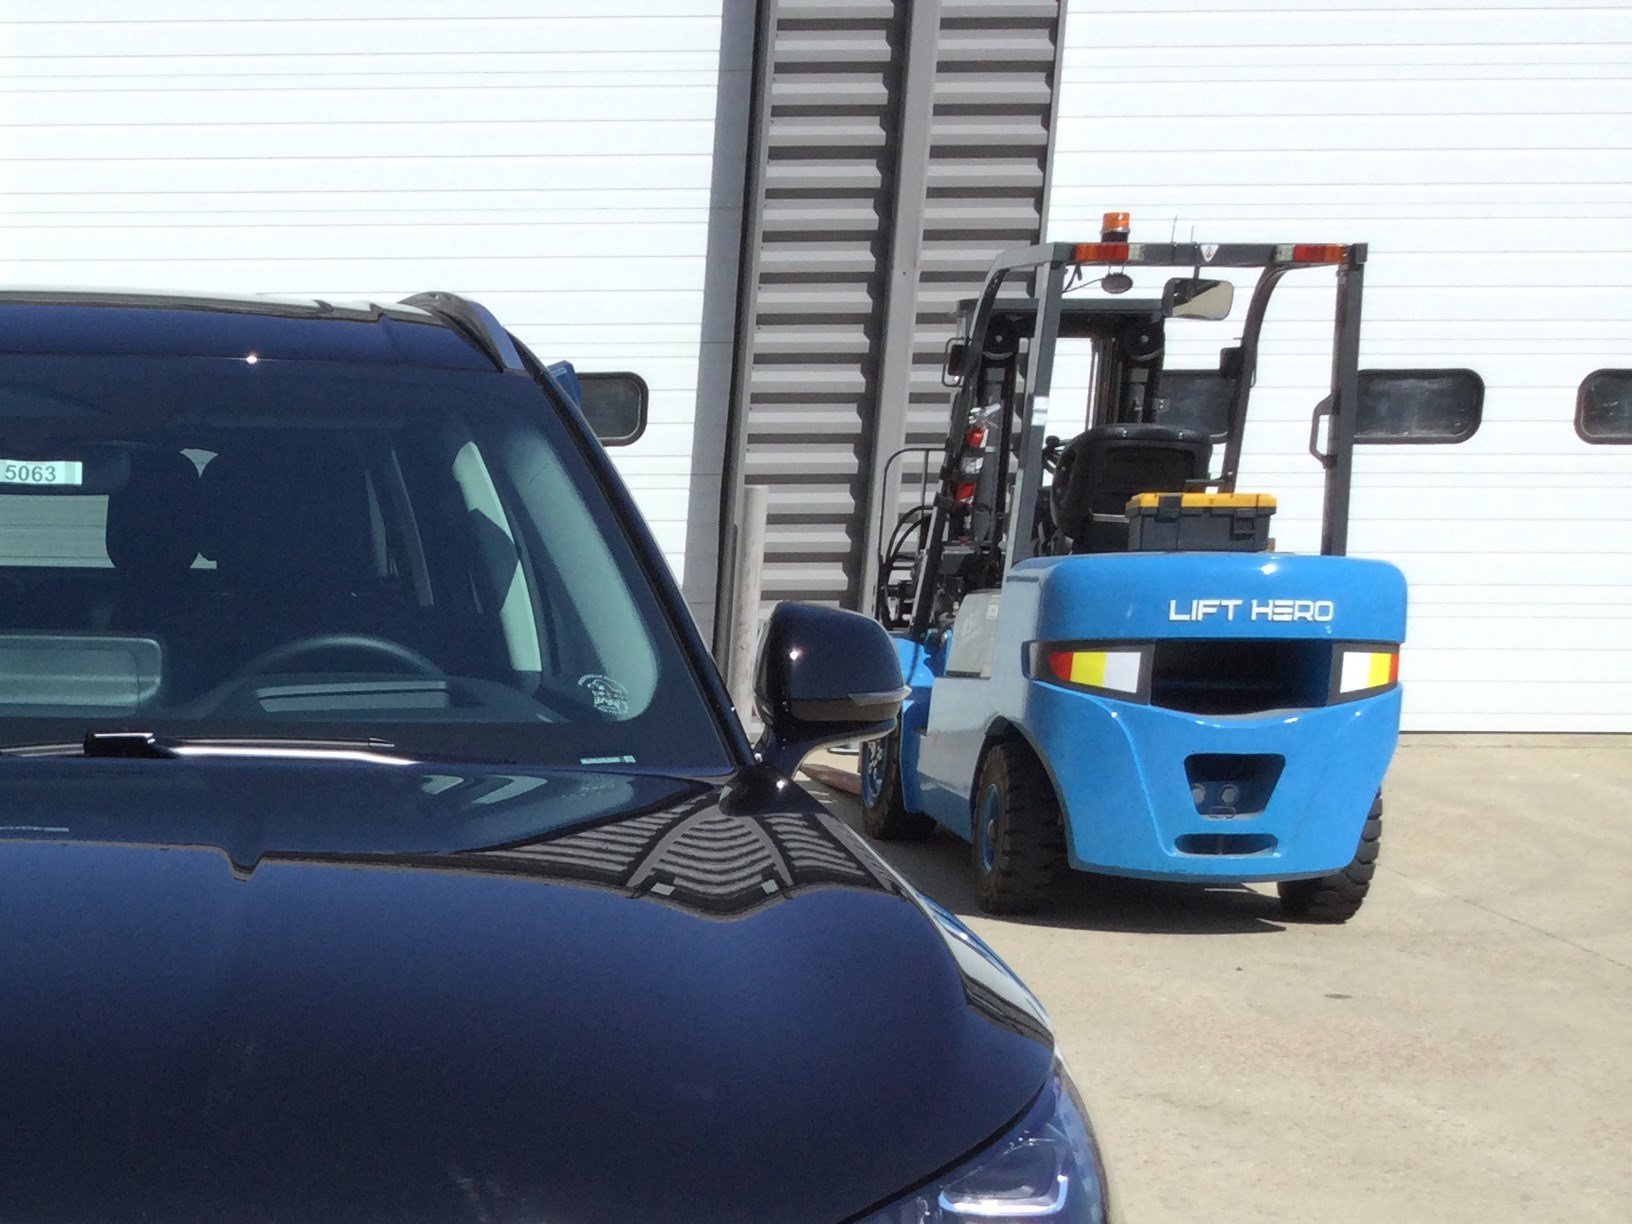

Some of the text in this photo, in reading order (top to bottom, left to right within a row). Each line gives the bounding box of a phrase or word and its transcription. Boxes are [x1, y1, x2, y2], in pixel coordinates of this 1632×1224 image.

[4, 464, 56, 482] 5063
[1169, 599, 1334, 621] LIFT HERO
